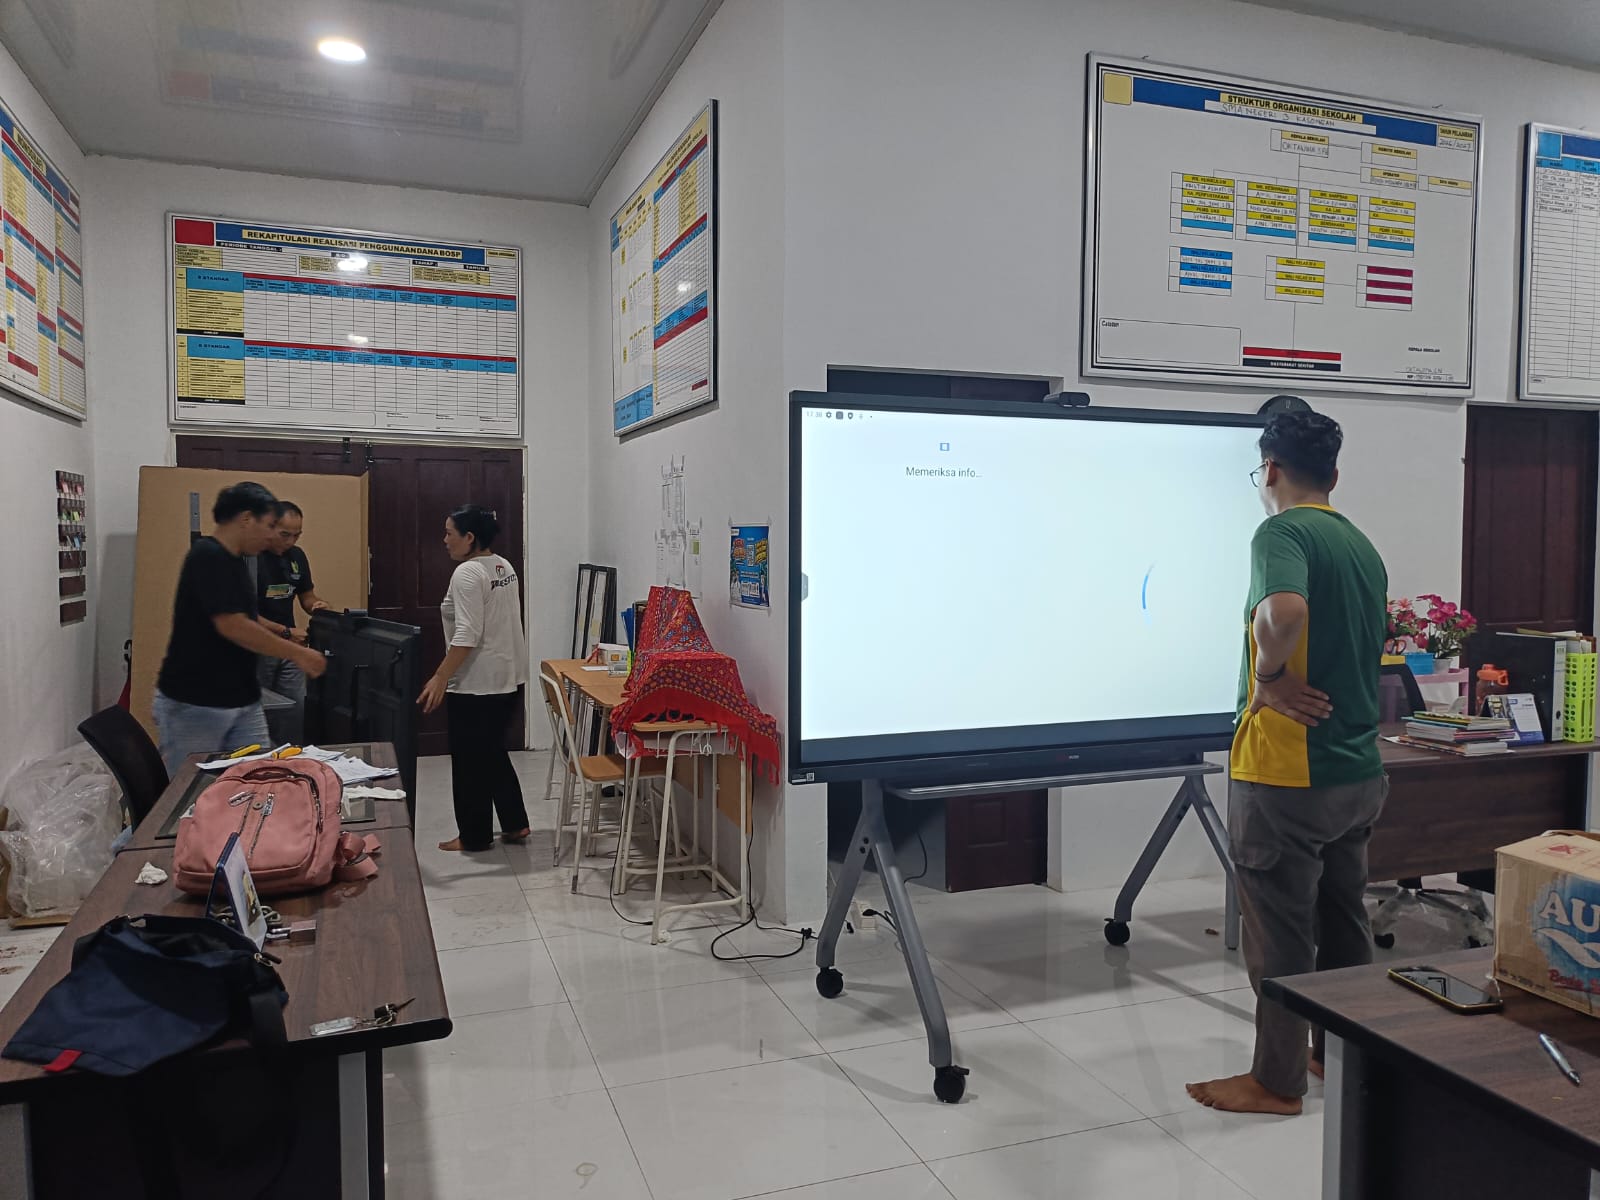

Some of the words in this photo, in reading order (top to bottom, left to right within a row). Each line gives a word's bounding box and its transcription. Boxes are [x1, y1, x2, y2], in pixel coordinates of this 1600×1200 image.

[1221, 102, 1243, 115] SMA
[1228, 95, 1271, 109] STRUKTUR
[1273, 102, 1320, 116] ORGANISASI
[1321, 109, 1356, 122] SEKOLAH
[247, 231, 311, 244] REKAPITULASI
[313, 237, 357, 249] REALISASI
[440, 249, 462, 259] BOSP
[906, 466, 956, 478] Memeriksa
